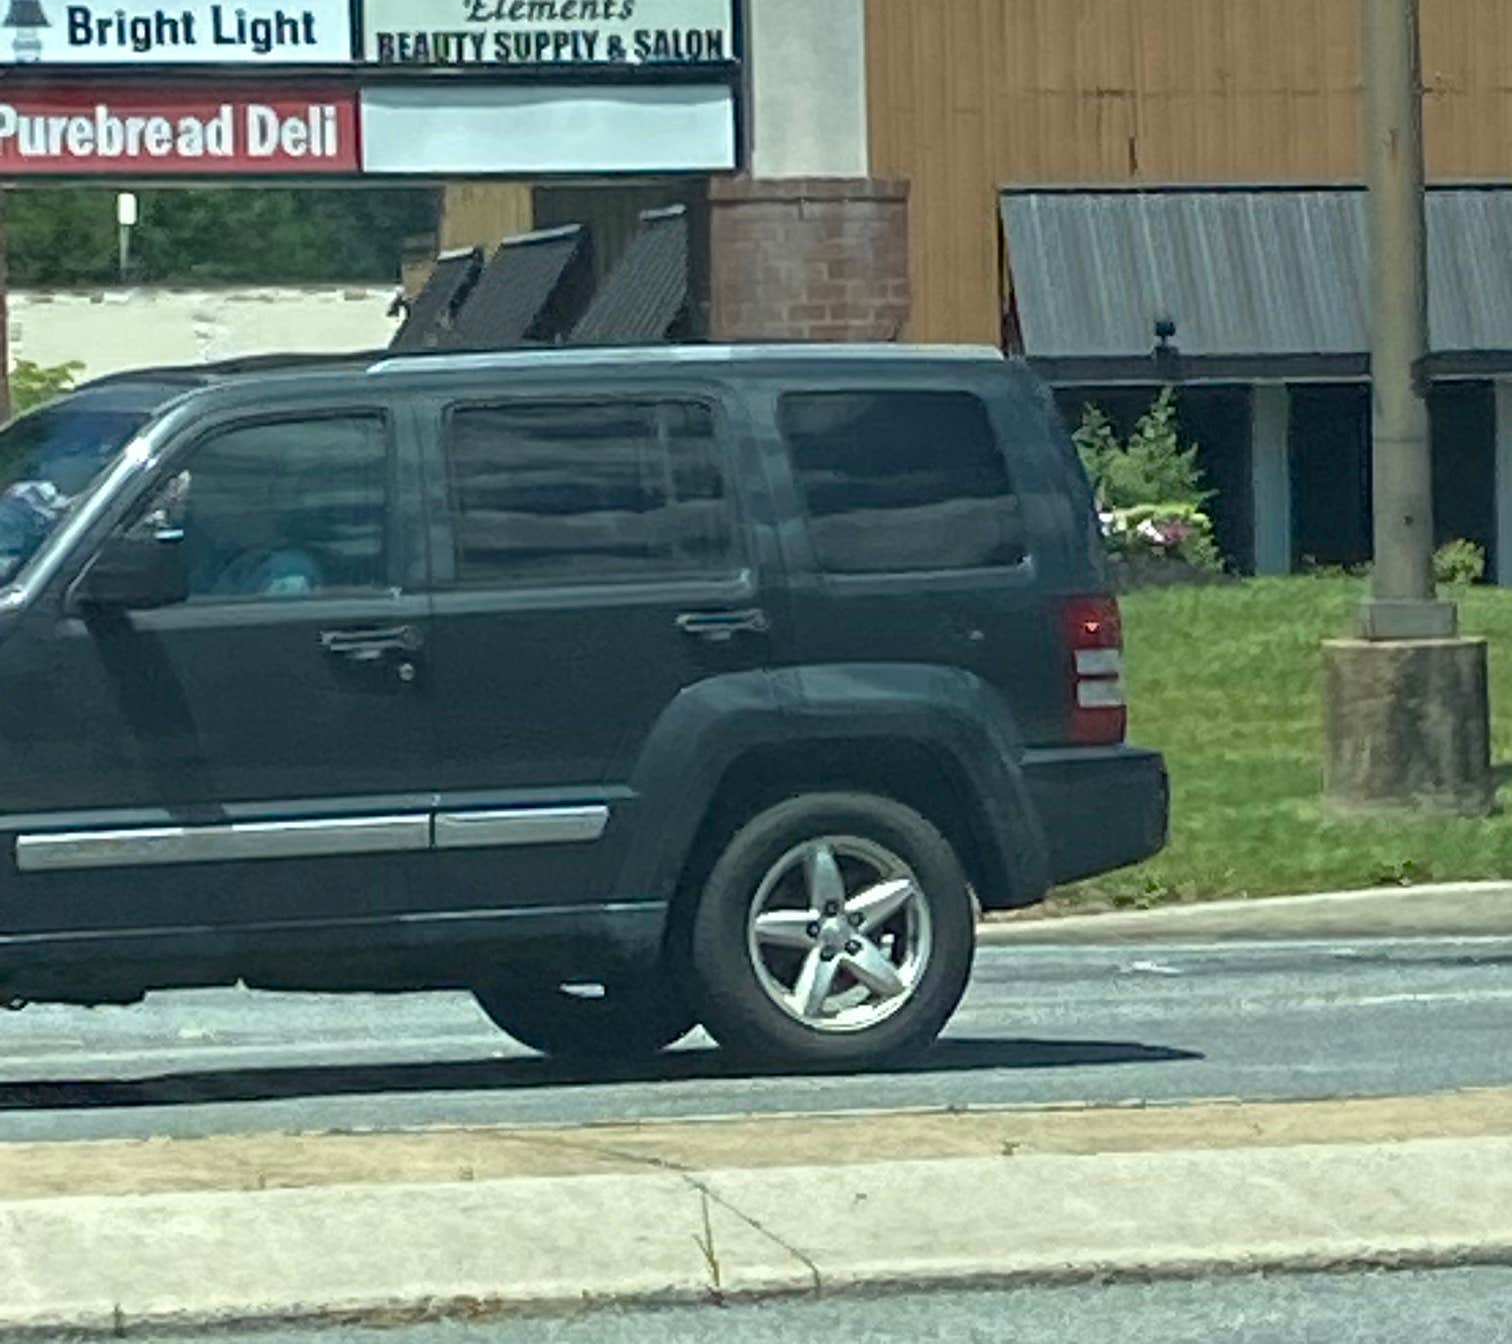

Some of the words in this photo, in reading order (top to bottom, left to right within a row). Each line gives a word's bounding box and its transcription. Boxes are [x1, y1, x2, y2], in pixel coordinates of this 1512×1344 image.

[67, 5, 198, 53] Bright
[210, 5, 319, 54] Light
[376, 31, 488, 62] BEAUTY
[493, 29, 600, 61] SUPPLY
[606, 35, 627, 62] &
[632, 29, 724, 59] SALON
[246, 103, 338, 157] Deli
